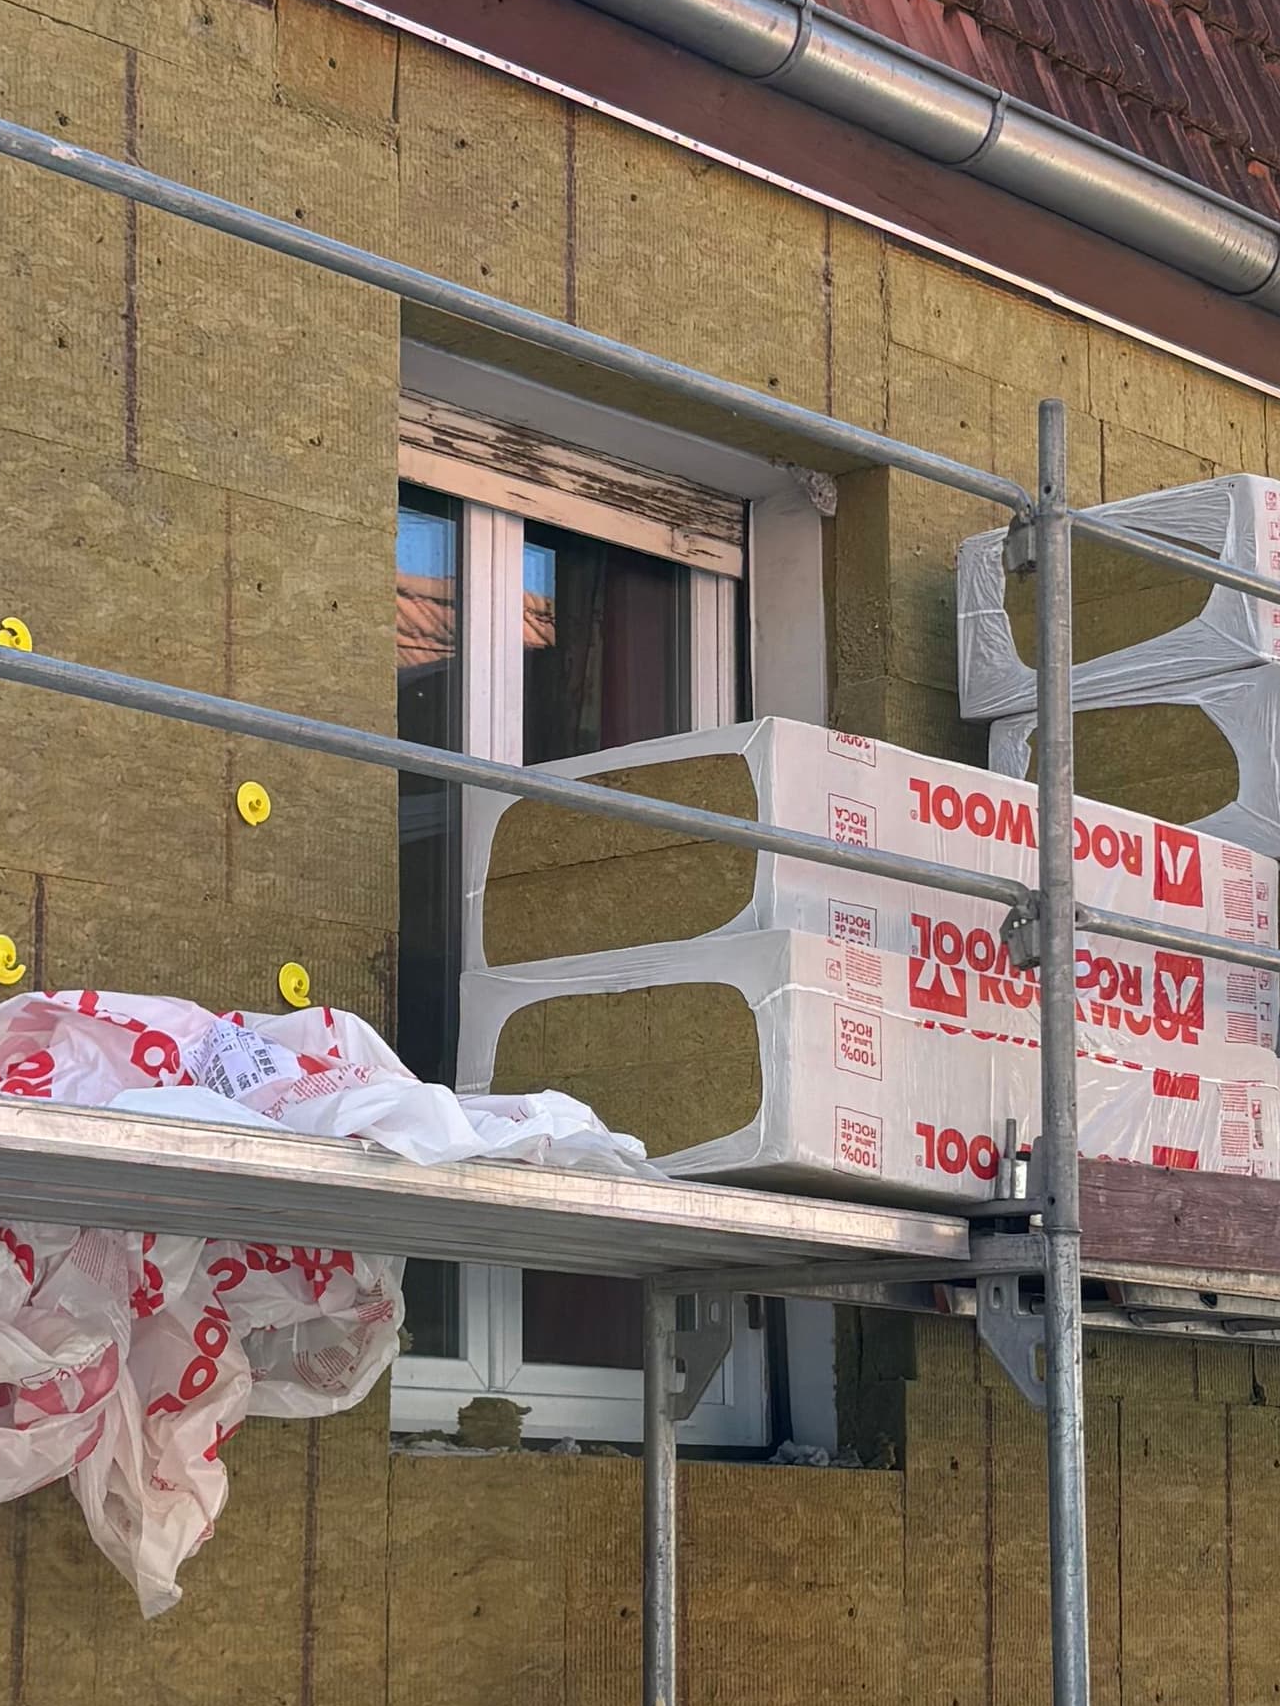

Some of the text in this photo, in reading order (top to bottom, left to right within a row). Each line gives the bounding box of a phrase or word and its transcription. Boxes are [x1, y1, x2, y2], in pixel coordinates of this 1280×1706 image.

[834, 806, 867, 828] ROCA
[834, 910, 870, 930] ROCHE
[840, 1017, 873, 1038] ROCA
[841, 1043, 877, 1067] 100%
[841, 1119, 877, 1139] ROCHE
[841, 1143, 877, 1168] 100%
